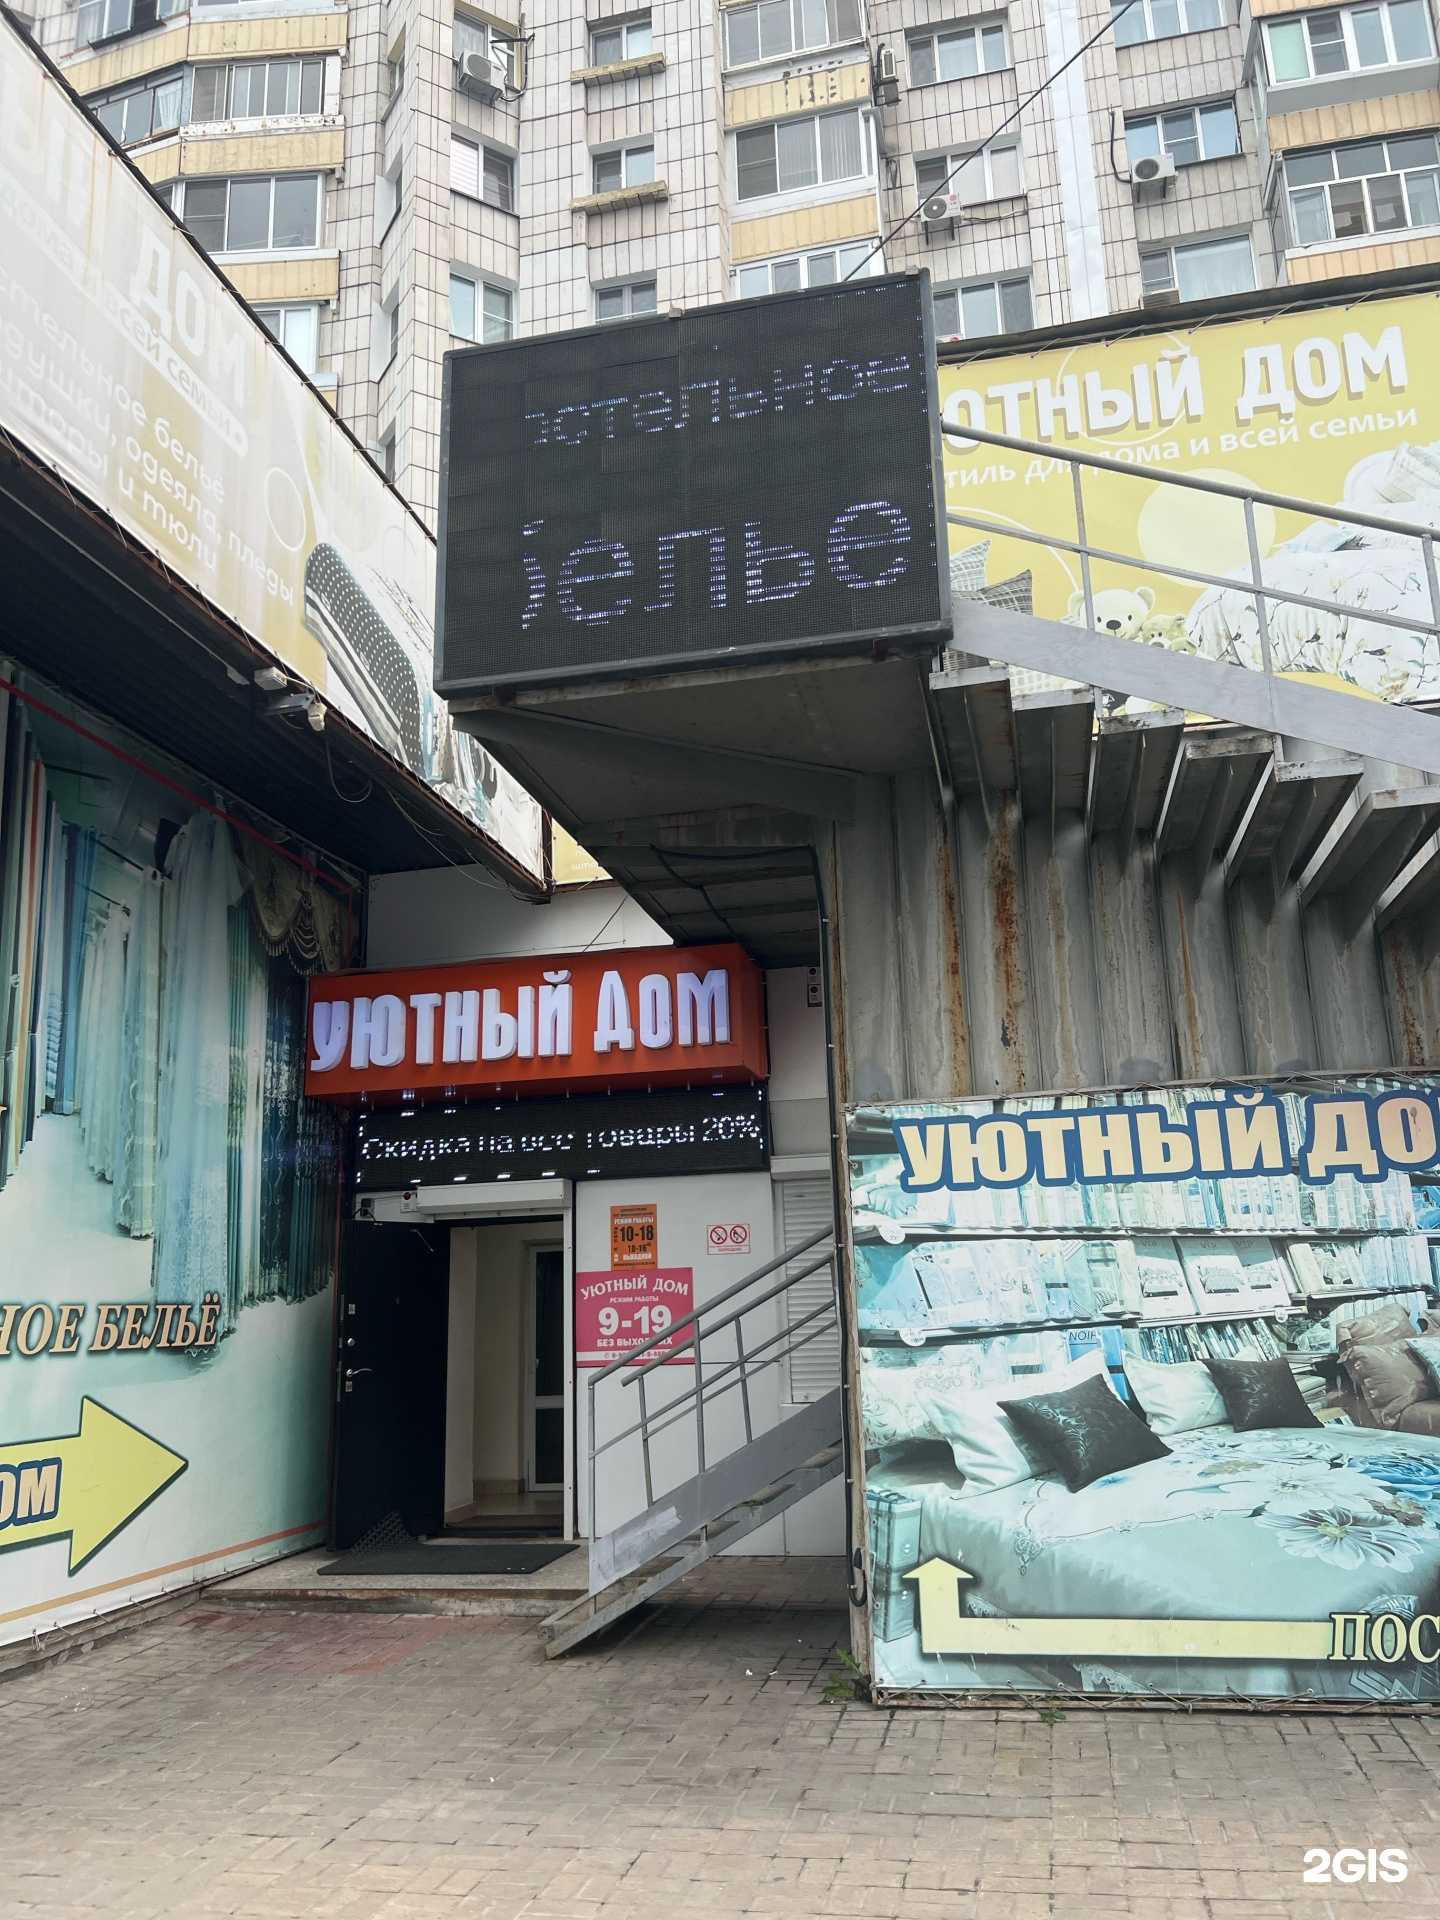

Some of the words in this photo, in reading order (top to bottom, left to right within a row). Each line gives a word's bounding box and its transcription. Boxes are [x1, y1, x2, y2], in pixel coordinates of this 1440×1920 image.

[129, 222, 245, 407] ДОМ
[1236, 325, 1409, 420] ДОМ
[1189, 436, 1211, 456] и
[1219, 416, 1300, 453] всей
[1308, 407, 1419, 440] семьи
[142, 489, 218, 574] тюли
[228, 530, 295, 606] пледы
[310, 969, 573, 1072] УЮТНЫЙ
[593, 968, 731, 1053] ДОМ
[901, 1093, 1282, 1184] УЮТНЫЙ
[619, 1225, 654, 1242] 10-18
[580, 1275, 647, 1299] УЮТНЫЙ
[652, 1279, 689, 1296] ДОМ
[88, 1292, 221, 1351] БЕЛЬЁ
[597, 1339, 615, 1347] БЕЗ
[598, 1305, 672, 1336] 9-19
[1329, 1614, 1440, 1663] ПОС
